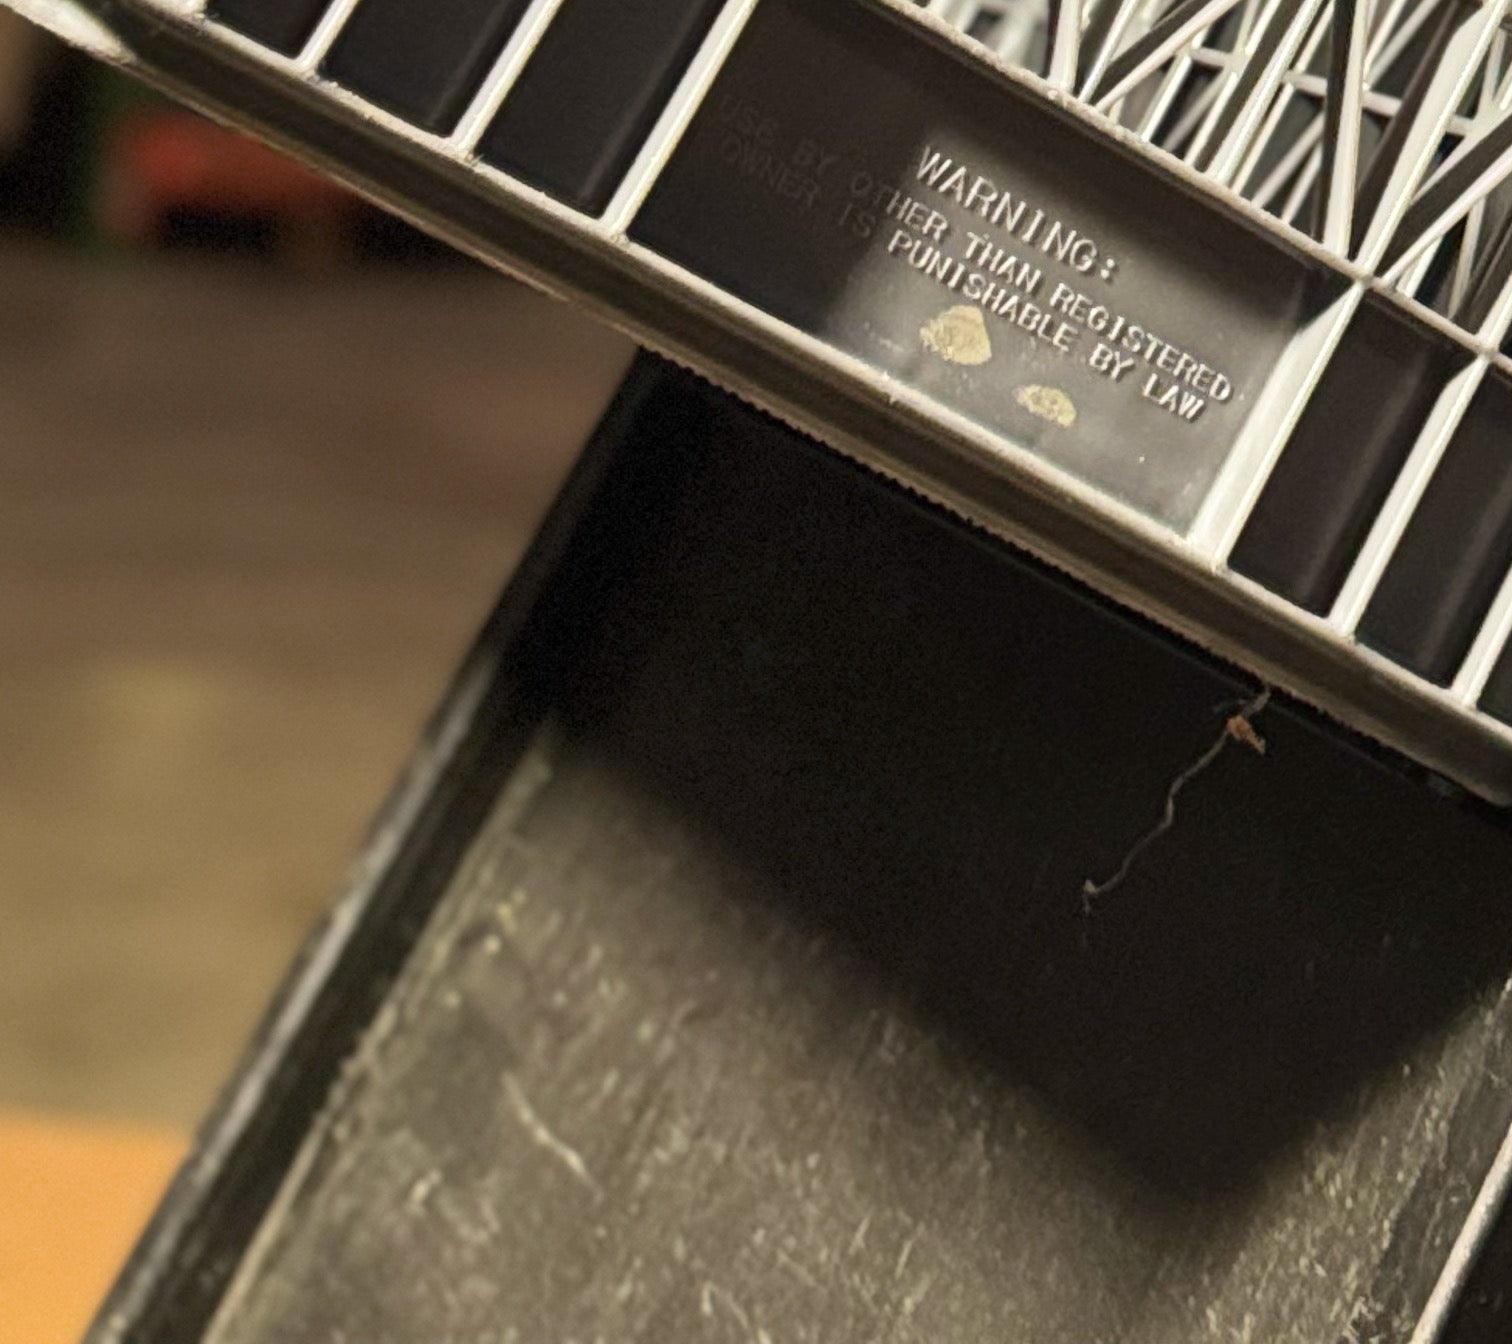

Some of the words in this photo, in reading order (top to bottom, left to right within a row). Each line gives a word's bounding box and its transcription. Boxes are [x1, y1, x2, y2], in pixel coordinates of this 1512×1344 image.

[720, 127, 820, 209] OWNER
[838, 202, 876, 238] IS
[888, 232, 1074, 352] PUNISHABLE
[1090, 344, 1136, 381] BY
[1142, 374, 1207, 423] LAW
[791, 137, 841, 175] BY
[851, 170, 947, 241] OTHER
[964, 232, 1041, 292] THAN
[1050, 280, 1232, 402] REGISTERED
[916, 146, 1118, 279] WARNING:
